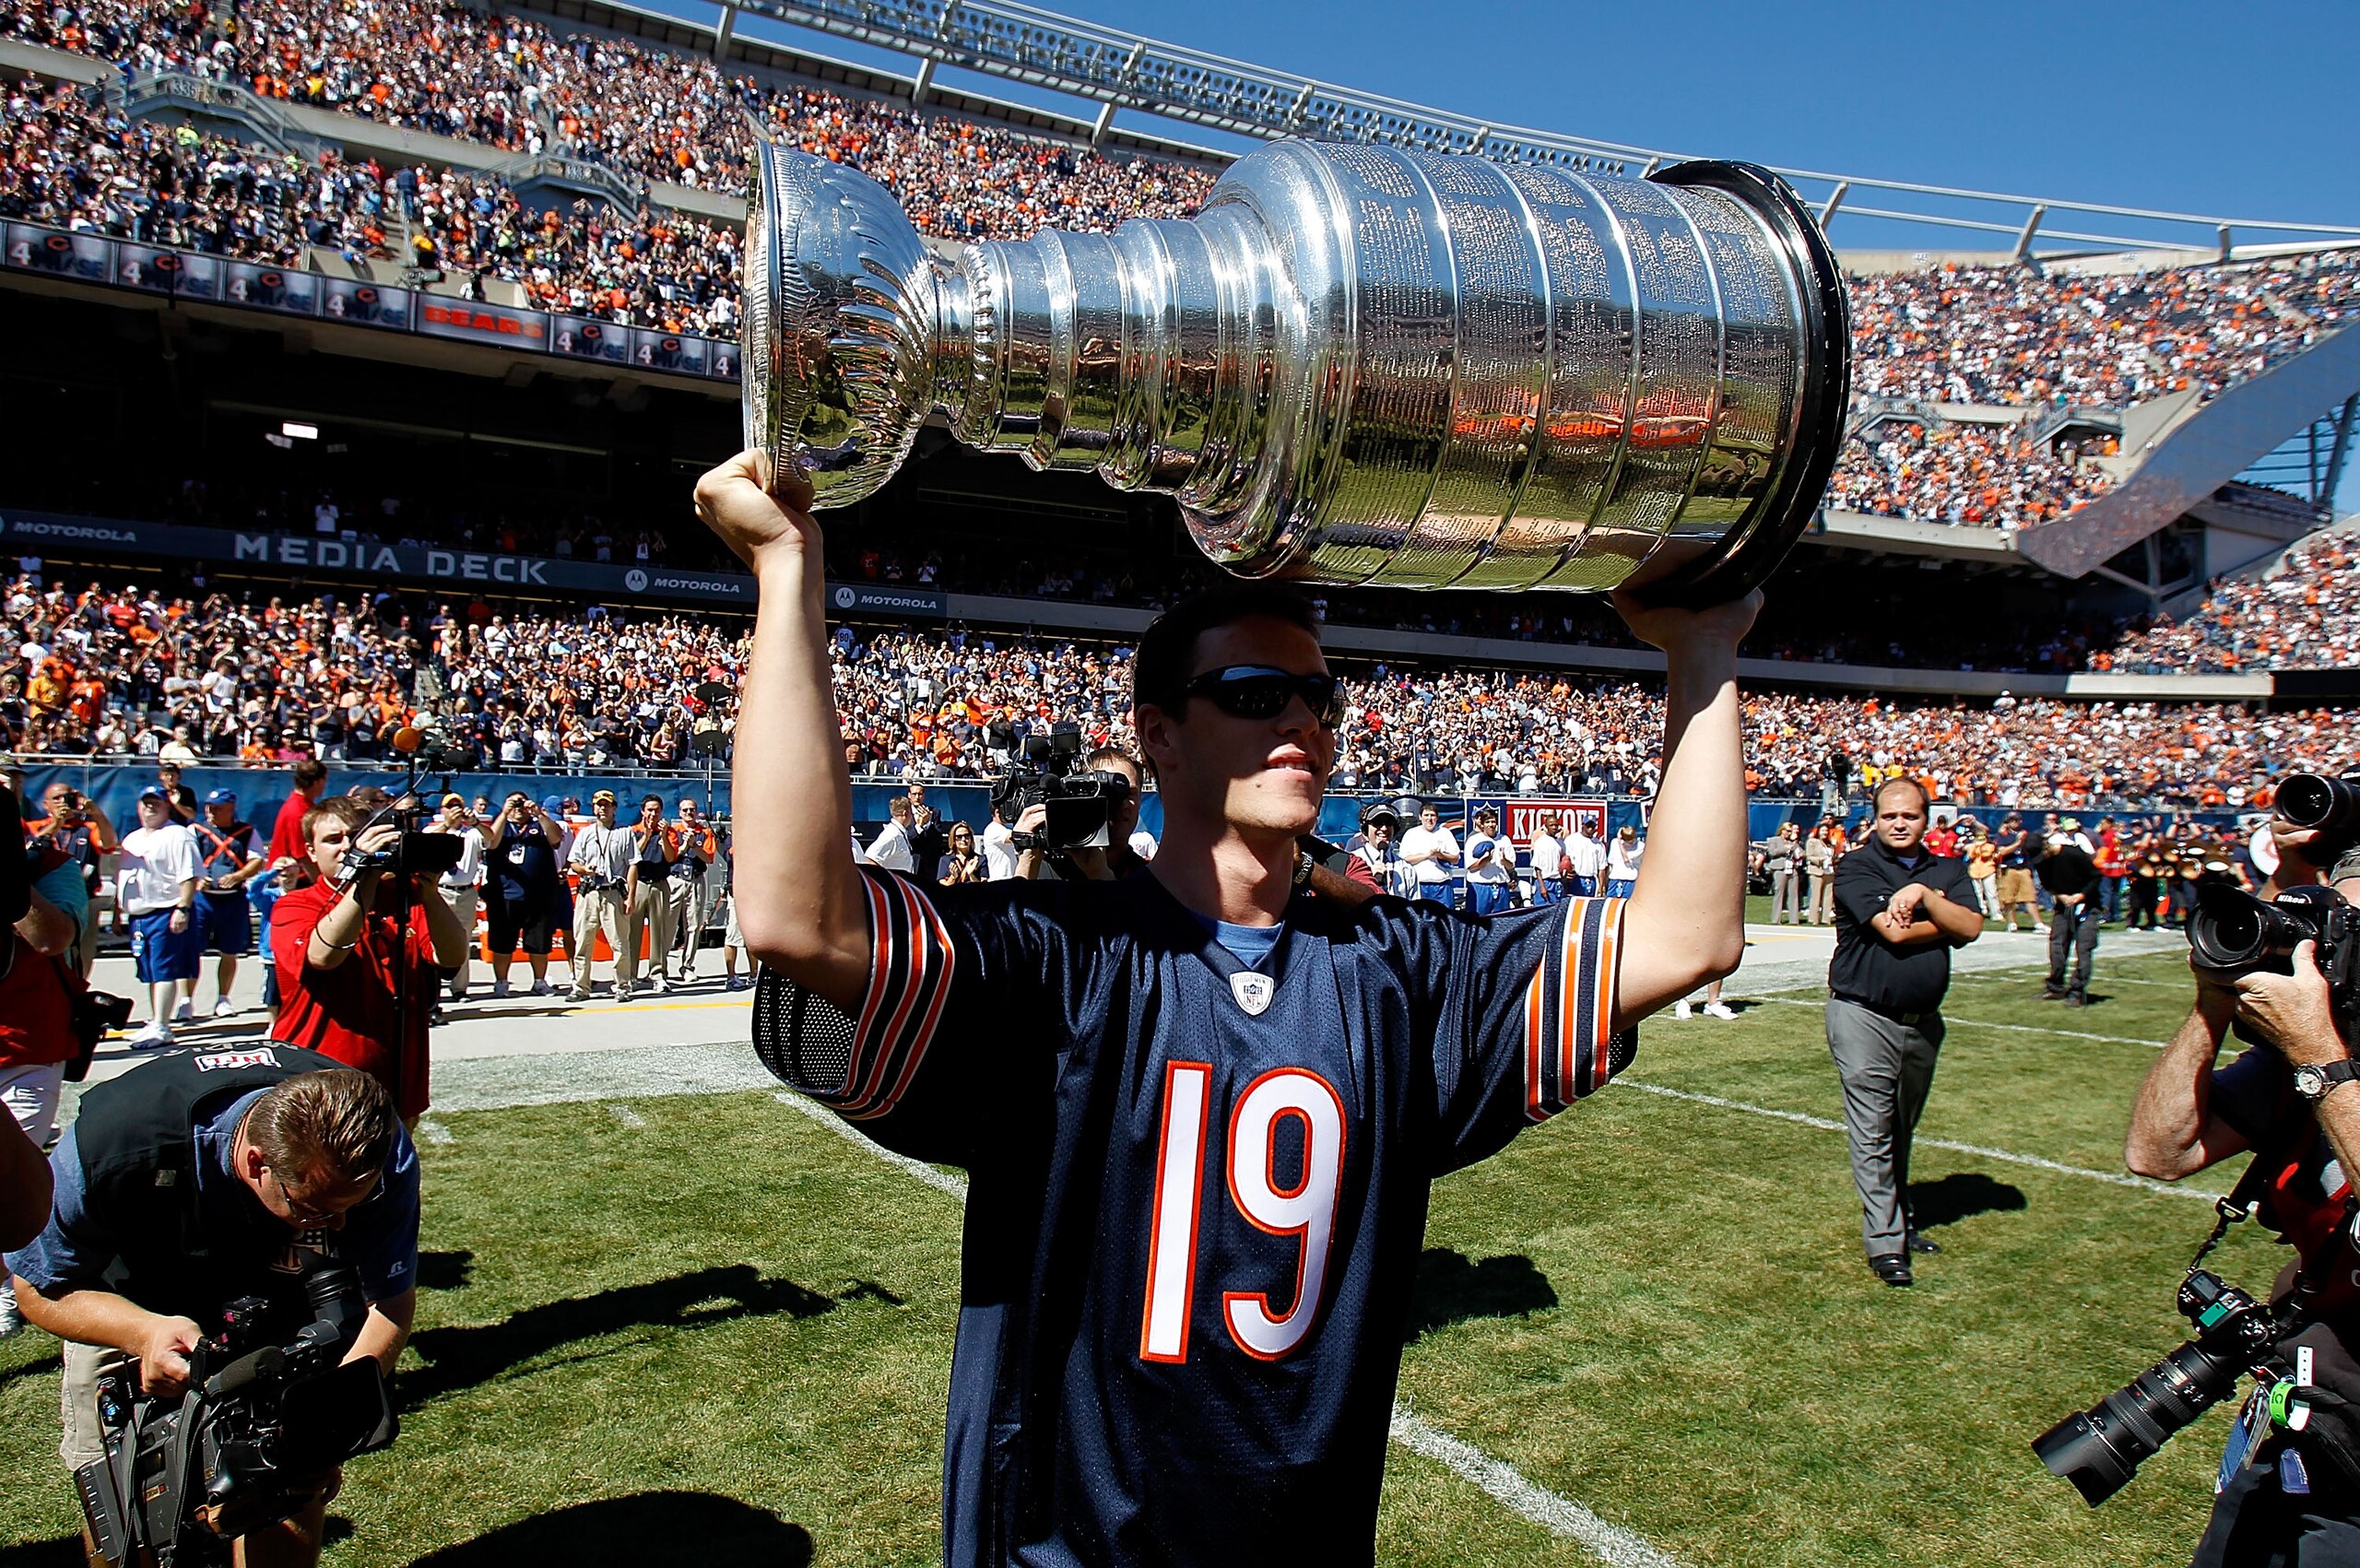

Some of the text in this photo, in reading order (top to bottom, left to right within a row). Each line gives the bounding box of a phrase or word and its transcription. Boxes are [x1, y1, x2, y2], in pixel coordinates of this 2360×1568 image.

[11, 242, 30, 265] 4
[122, 261, 141, 286] 4
[230, 278, 248, 302] 4
[326, 293, 346, 317] 4
[424, 305, 543, 338] BEARS
[557, 331, 572, 352] 4
[637, 344, 653, 364] 4
[715, 355, 729, 375] 4
[14, 522, 137, 543] MOTOROLA
[234, 533, 548, 585] MEDIA DECK
[654, 577, 740, 595] MOTOROLA
[860, 595, 938, 609] MOTOROLA
[889, 658, 899, 670] 82
[1421, 758, 1430, 772] 51
[1512, 808, 1600, 841] KICOF
[2277, 893, 2307, 904] Nikon
[1245, 995, 1262, 1007] NFL
[1139, 1059, 1348, 1365] 19
